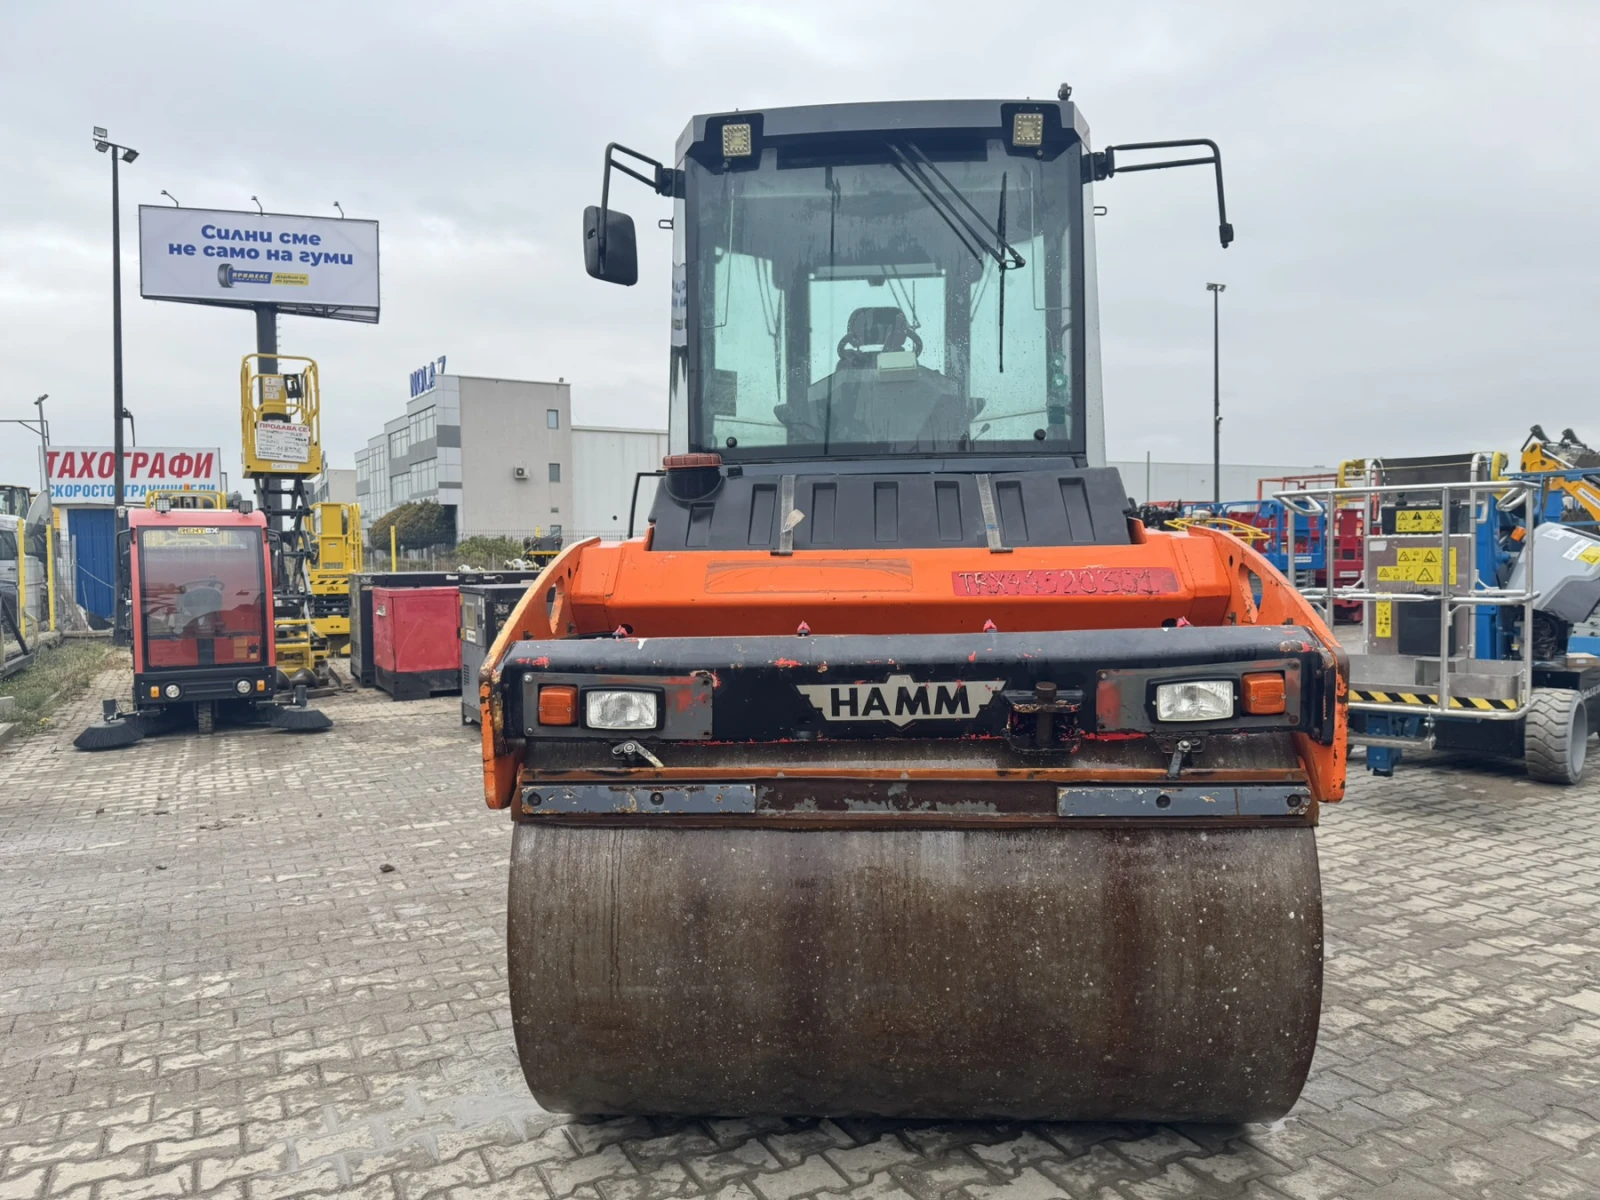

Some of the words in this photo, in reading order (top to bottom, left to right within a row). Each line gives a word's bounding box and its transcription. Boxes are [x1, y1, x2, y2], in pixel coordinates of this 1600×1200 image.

[201, 224, 272, 243] Силни
[279, 232, 322, 246] сме
[168, 243, 197, 256] не
[203, 246, 260, 260] само
[266, 249, 293, 262] на
[299, 250, 354, 267] гуми
[259, 422, 297, 431] ПРОДАВА
[47, 451, 214, 479] ТАХОРАФИ
[50, 484, 216, 498] СКОРОСТОГРА
[830, 685, 971, 717] HAMM
